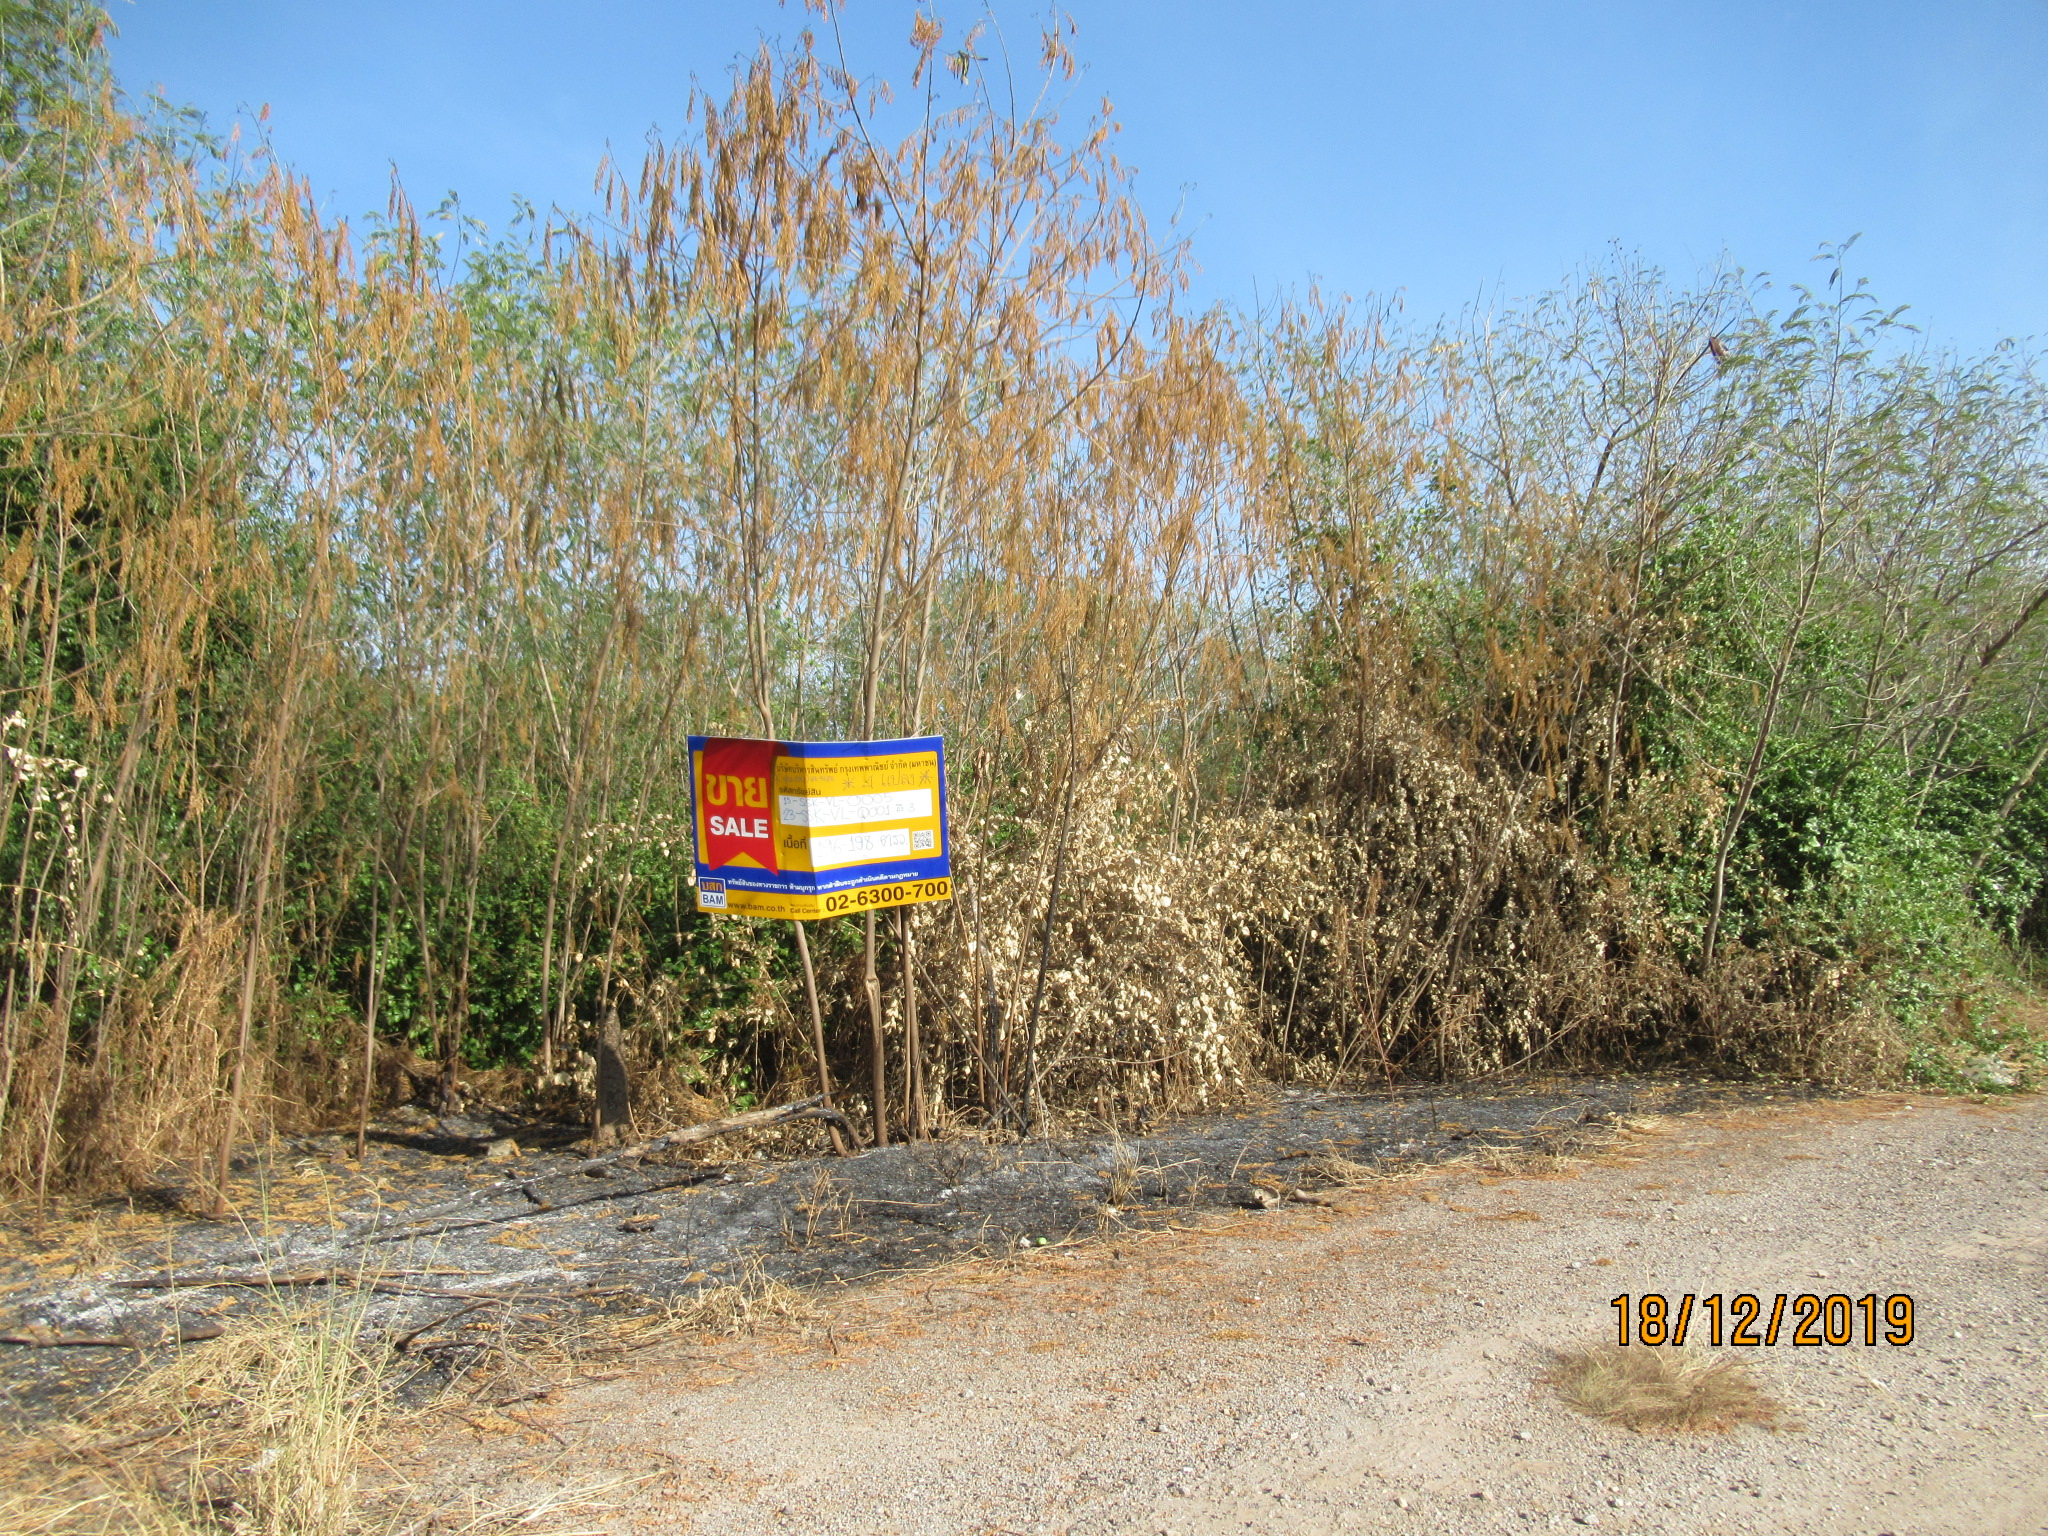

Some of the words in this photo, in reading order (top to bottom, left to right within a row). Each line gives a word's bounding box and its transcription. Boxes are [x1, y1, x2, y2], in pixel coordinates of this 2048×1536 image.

[840, 760, 889, 775] กรุงเทพพาณิชย์
[890, 759, 908, 770] จำกัด
[909, 758, 937, 770] (มหาชน)
[706, 774, 768, 808] ขาย
[710, 815, 769, 839] SALE
[783, 836, 807, 850] เนื้อที่
[701, 880, 723, 891] บสก
[702, 894, 724, 905] BAM
[826, 881, 948, 912] 02-6300-700
[727, 902, 786, 913] www.bam.co.th
